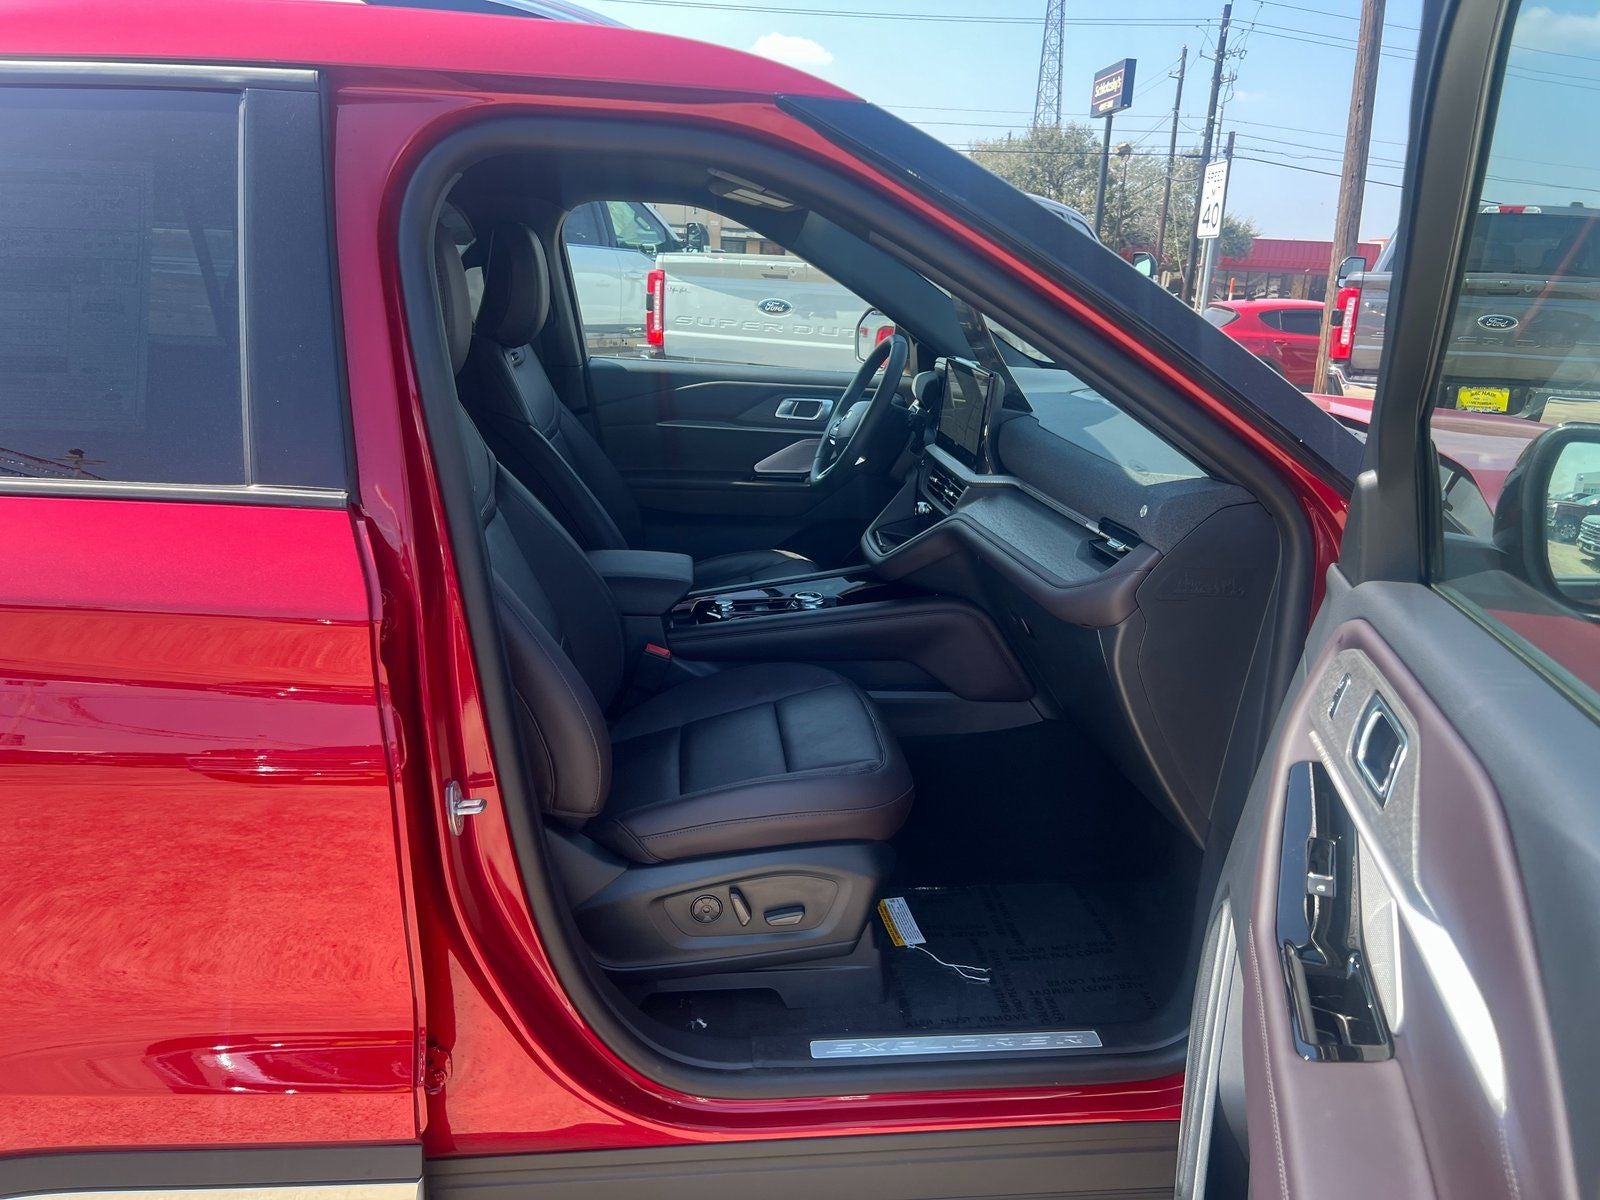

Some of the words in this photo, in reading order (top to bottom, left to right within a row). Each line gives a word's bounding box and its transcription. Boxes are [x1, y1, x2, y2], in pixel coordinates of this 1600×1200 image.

[1202, 202, 1220, 228] 40
[674, 315, 784, 334] SUPER
[792, 323, 857, 338] DUT
[826, 1034, 1084, 1055] EXPLORER
